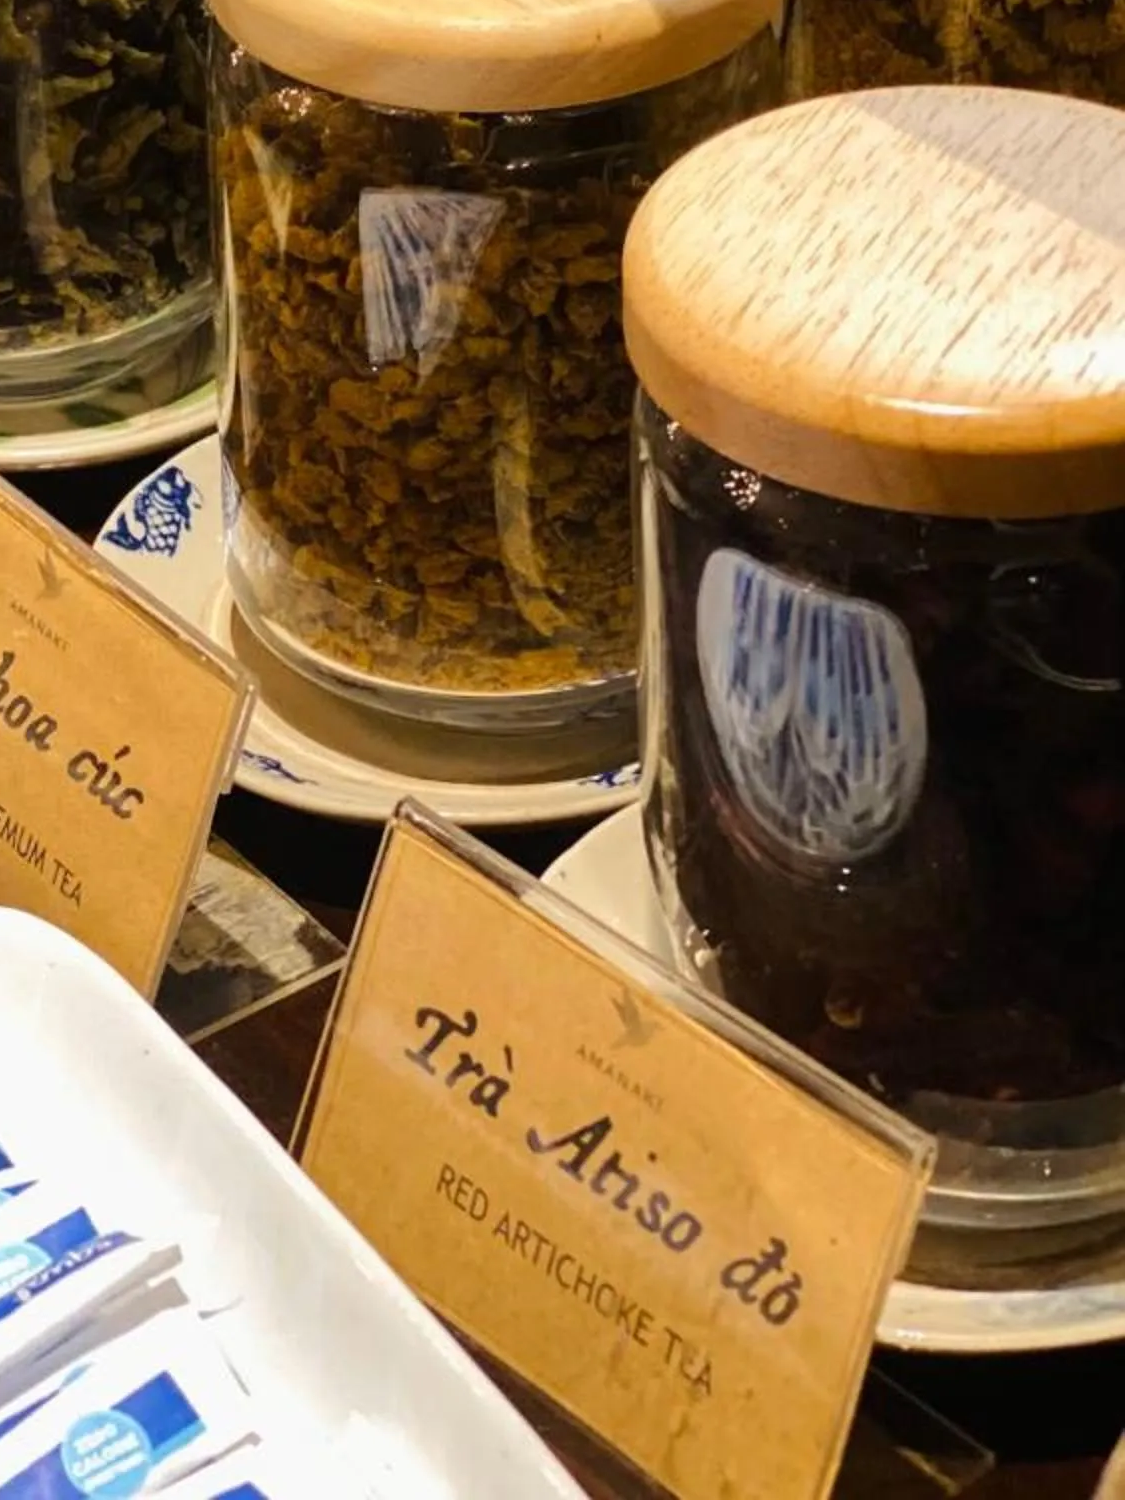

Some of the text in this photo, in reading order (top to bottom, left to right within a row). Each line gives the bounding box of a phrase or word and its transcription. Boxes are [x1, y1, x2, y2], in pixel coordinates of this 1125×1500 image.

[66, 746, 146, 822] cúc
[51, 858, 84, 908] TEA
[574, 1044, 665, 1109] AMANAKI
[403, 1005, 805, 1327] Trà Atiso đỏ
[436, 1162, 715, 1396] RED ARTICHOKE TEA
